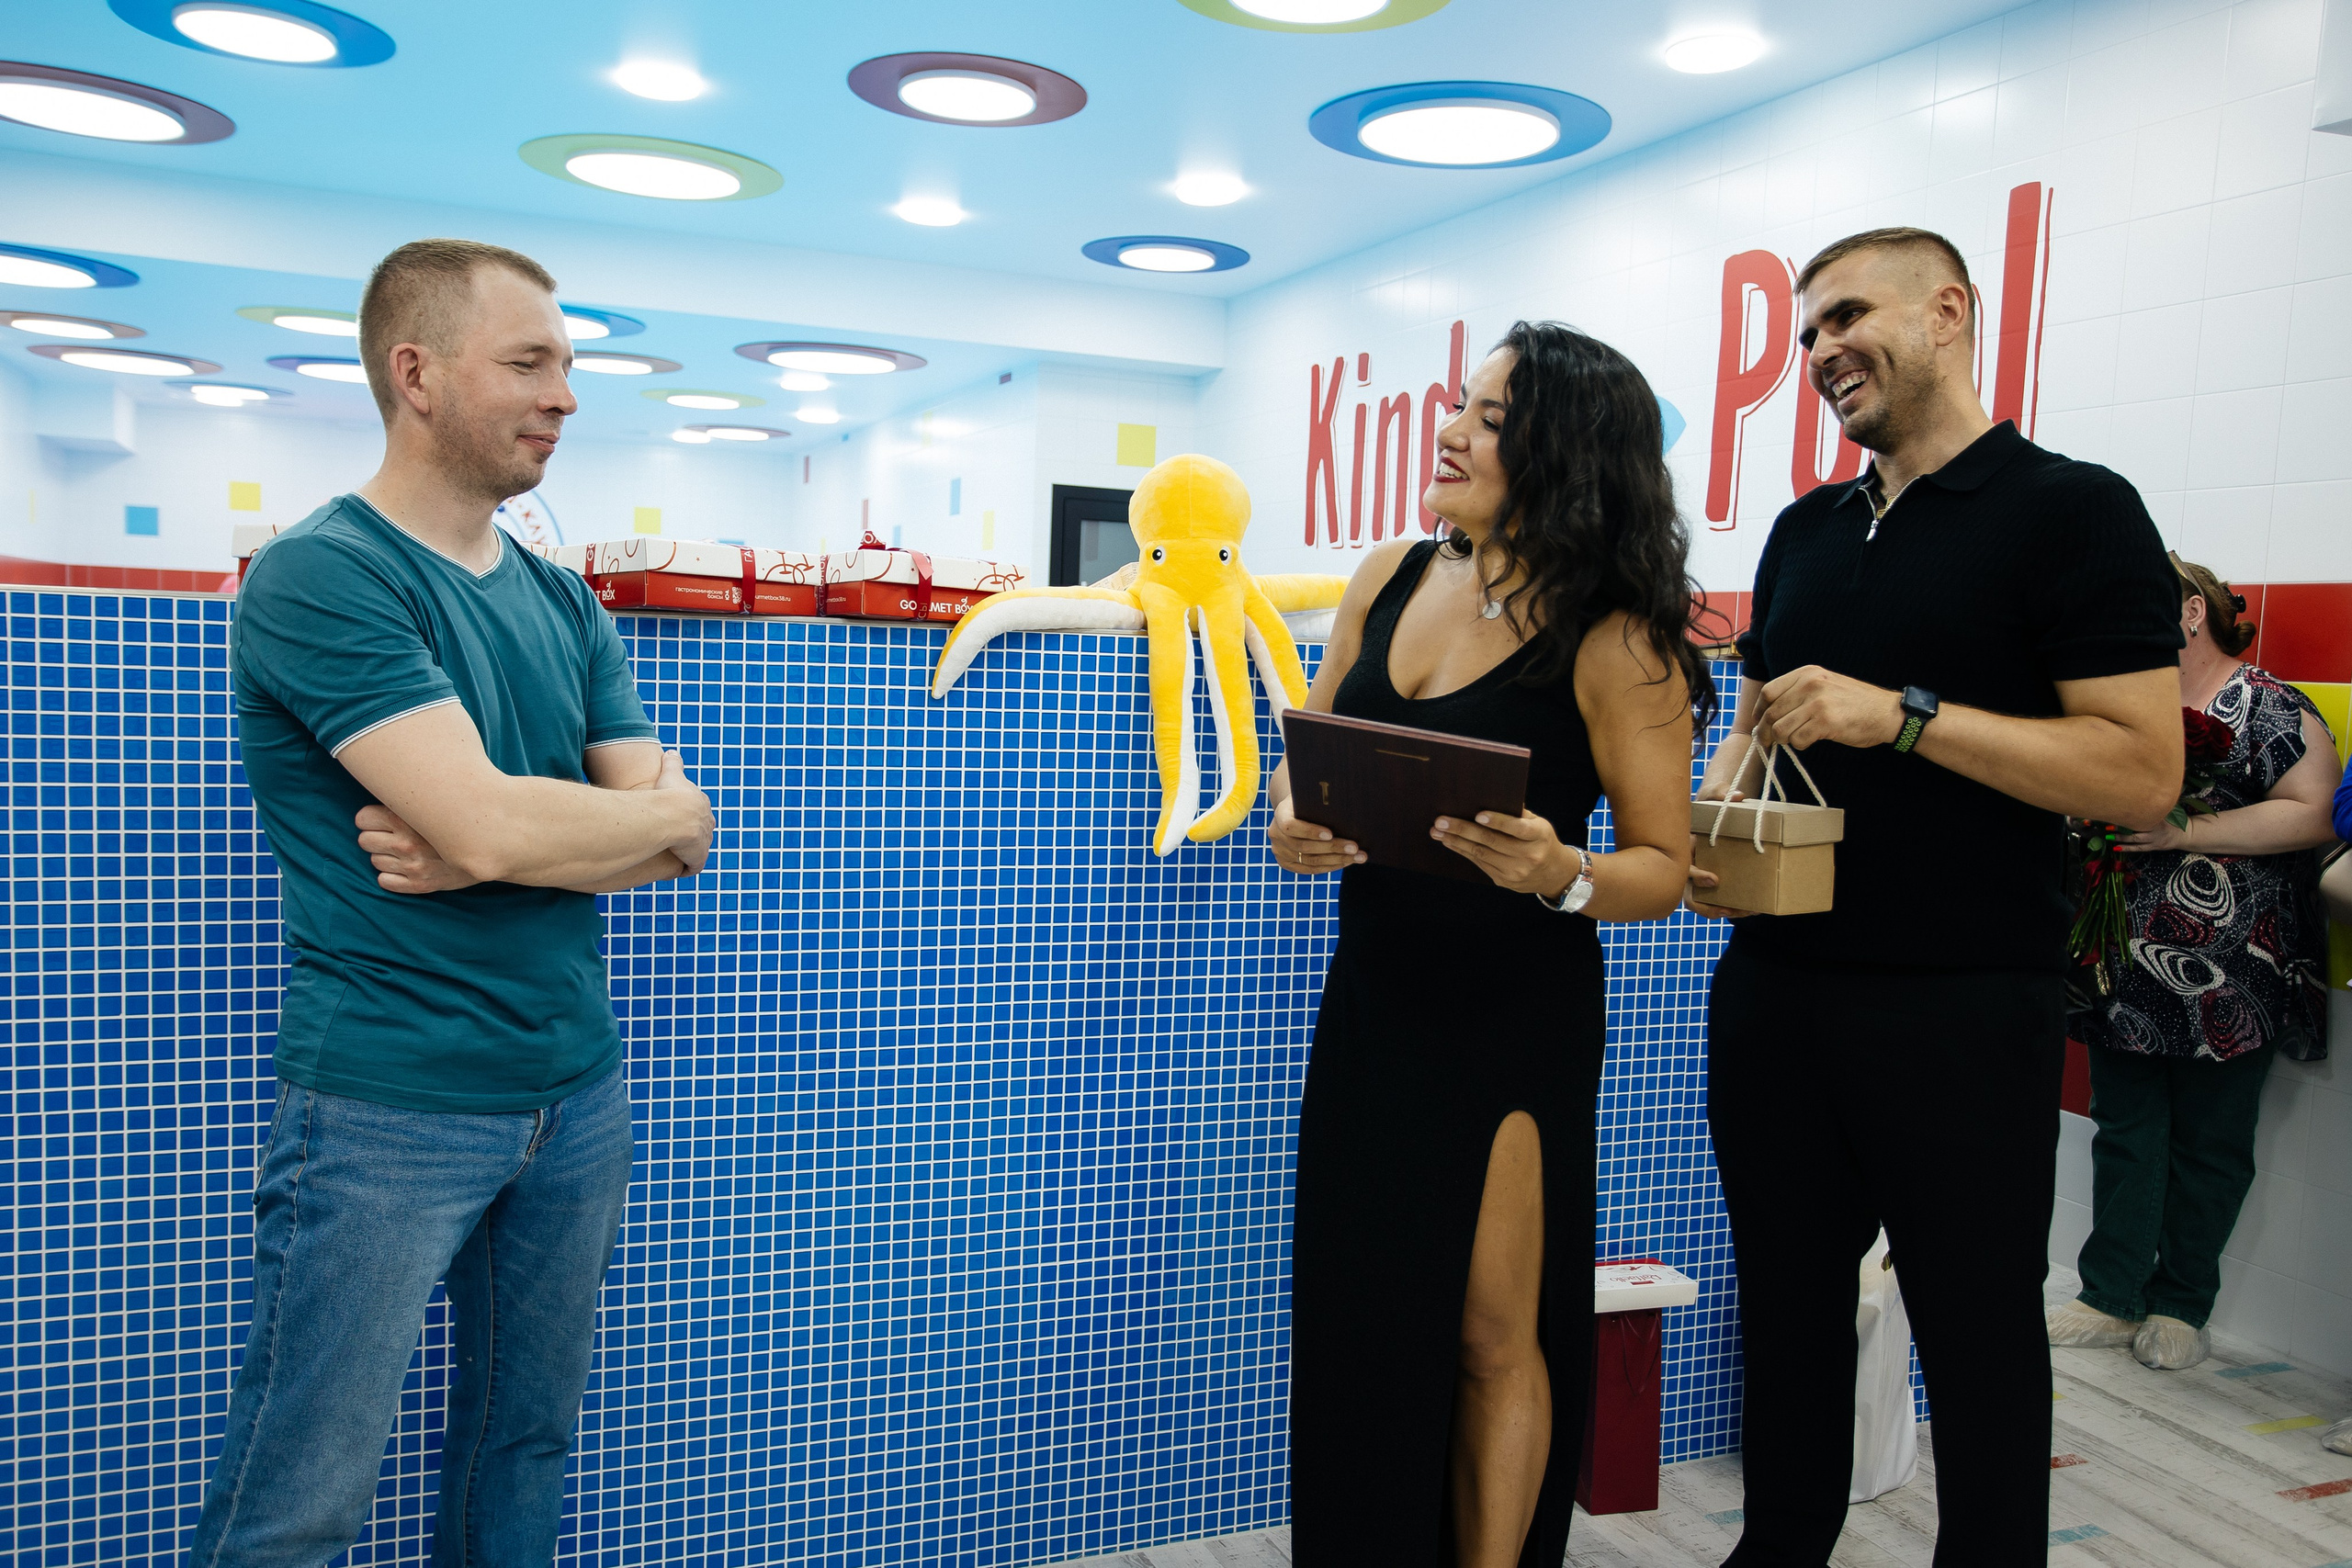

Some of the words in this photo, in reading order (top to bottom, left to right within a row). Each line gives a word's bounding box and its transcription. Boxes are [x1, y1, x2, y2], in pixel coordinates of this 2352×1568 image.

[1305, 319, 1471, 549] Kind
[1705, 180, 2053, 531] Pol
[899, 599, 953, 614] GOMET
